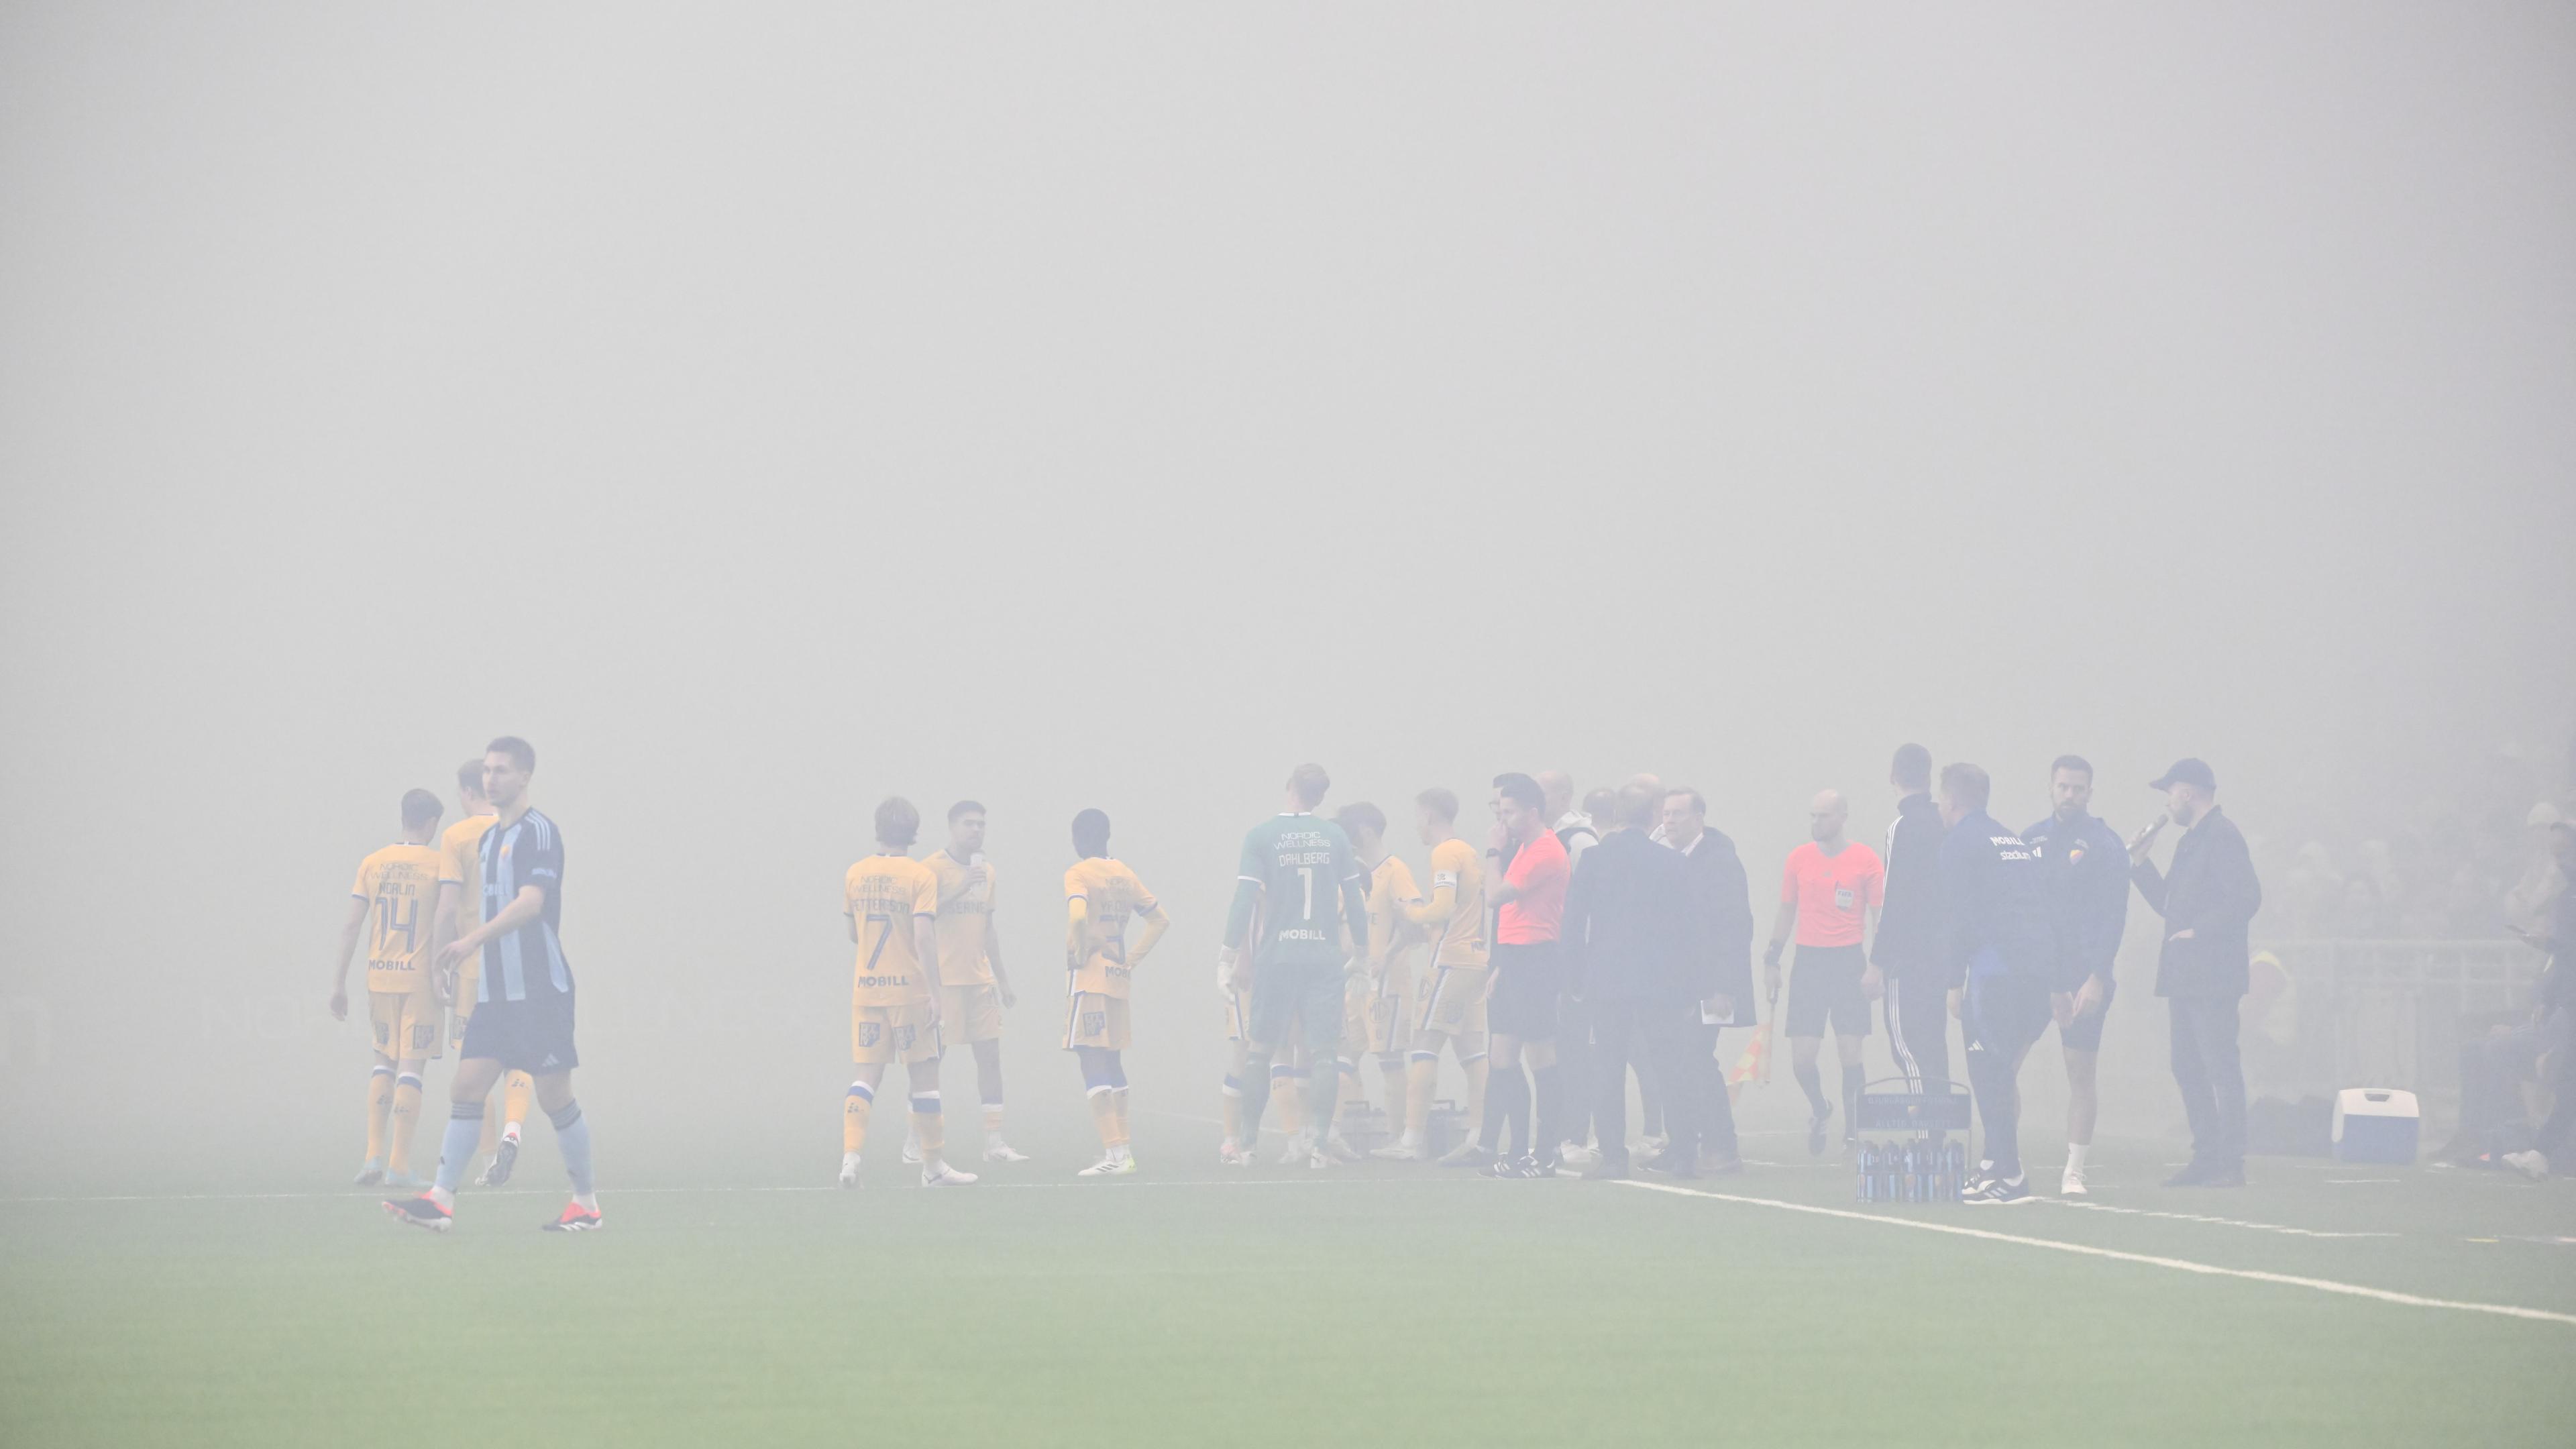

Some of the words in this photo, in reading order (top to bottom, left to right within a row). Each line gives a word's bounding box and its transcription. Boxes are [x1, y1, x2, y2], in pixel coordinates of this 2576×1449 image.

[1281, 831, 1321, 841] NORDIC
[1990, 836, 2026, 847] MOBILL
[1273, 839, 1331, 850] WELLNESS
[1278, 852, 1330, 867] DAHLBERG
[380, 863, 419, 871] NORDIC
[378, 881, 416, 896] NORLIN
[482, 883, 510, 896] OBILL
[1297, 867, 1312, 921] 1
[374, 896, 419, 954] 14
[1278, 928, 1326, 941] MOBILL
[865, 914, 894, 971] 7
[368, 959, 417, 971] MOBILL
[1105, 965, 1132, 978] MOBI
[857, 975, 910, 988] MOBILL
